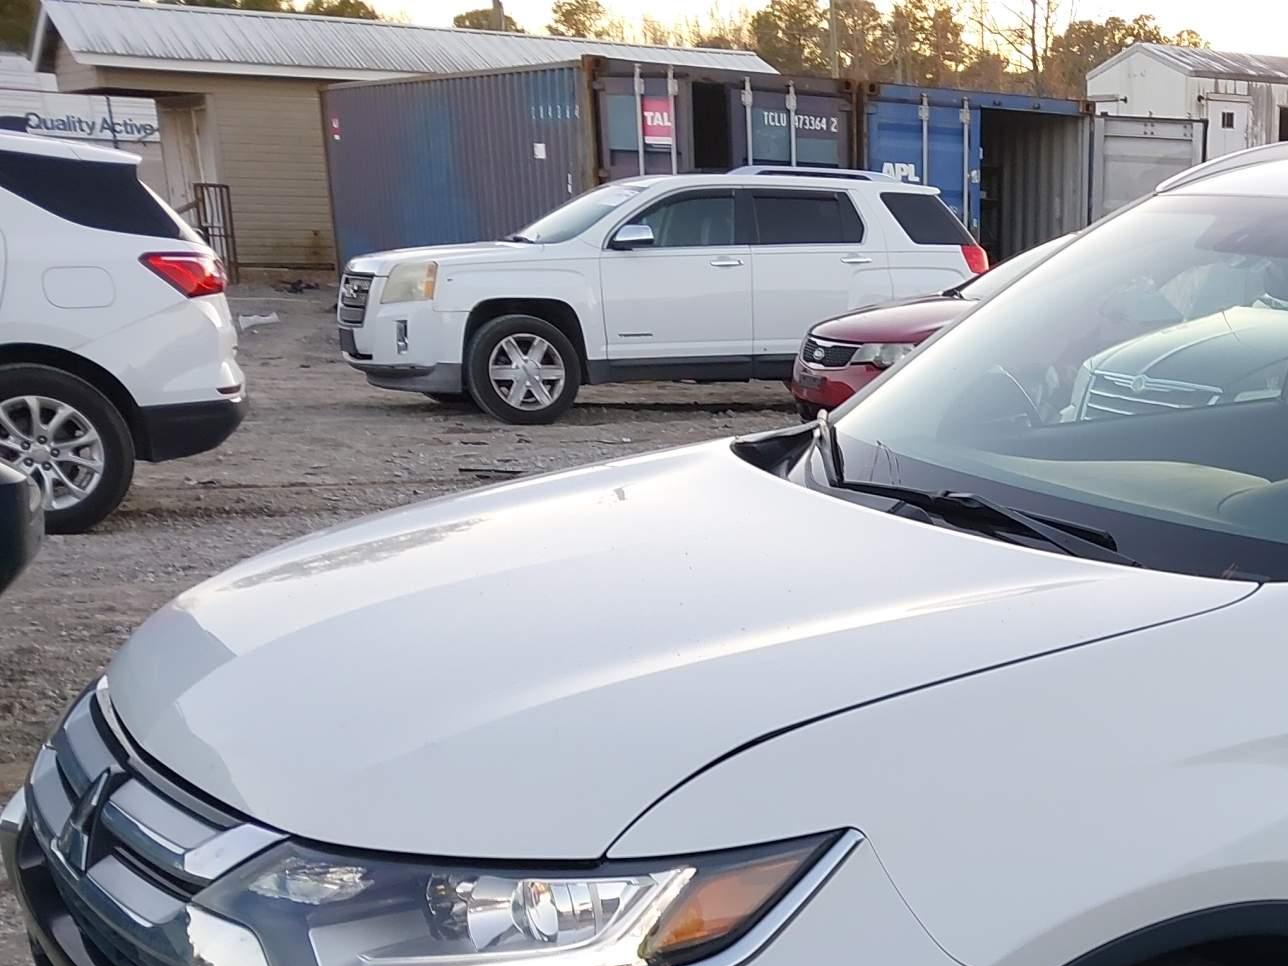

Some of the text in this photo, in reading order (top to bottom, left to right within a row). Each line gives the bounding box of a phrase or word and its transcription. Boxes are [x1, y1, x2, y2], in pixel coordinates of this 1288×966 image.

[25, 112, 155, 136] Quality Active
[643, 111, 672, 126] TAL
[763, 111, 787, 127] TCLU
[830, 117, 838, 132] 2
[882, 162, 920, 182] APL
